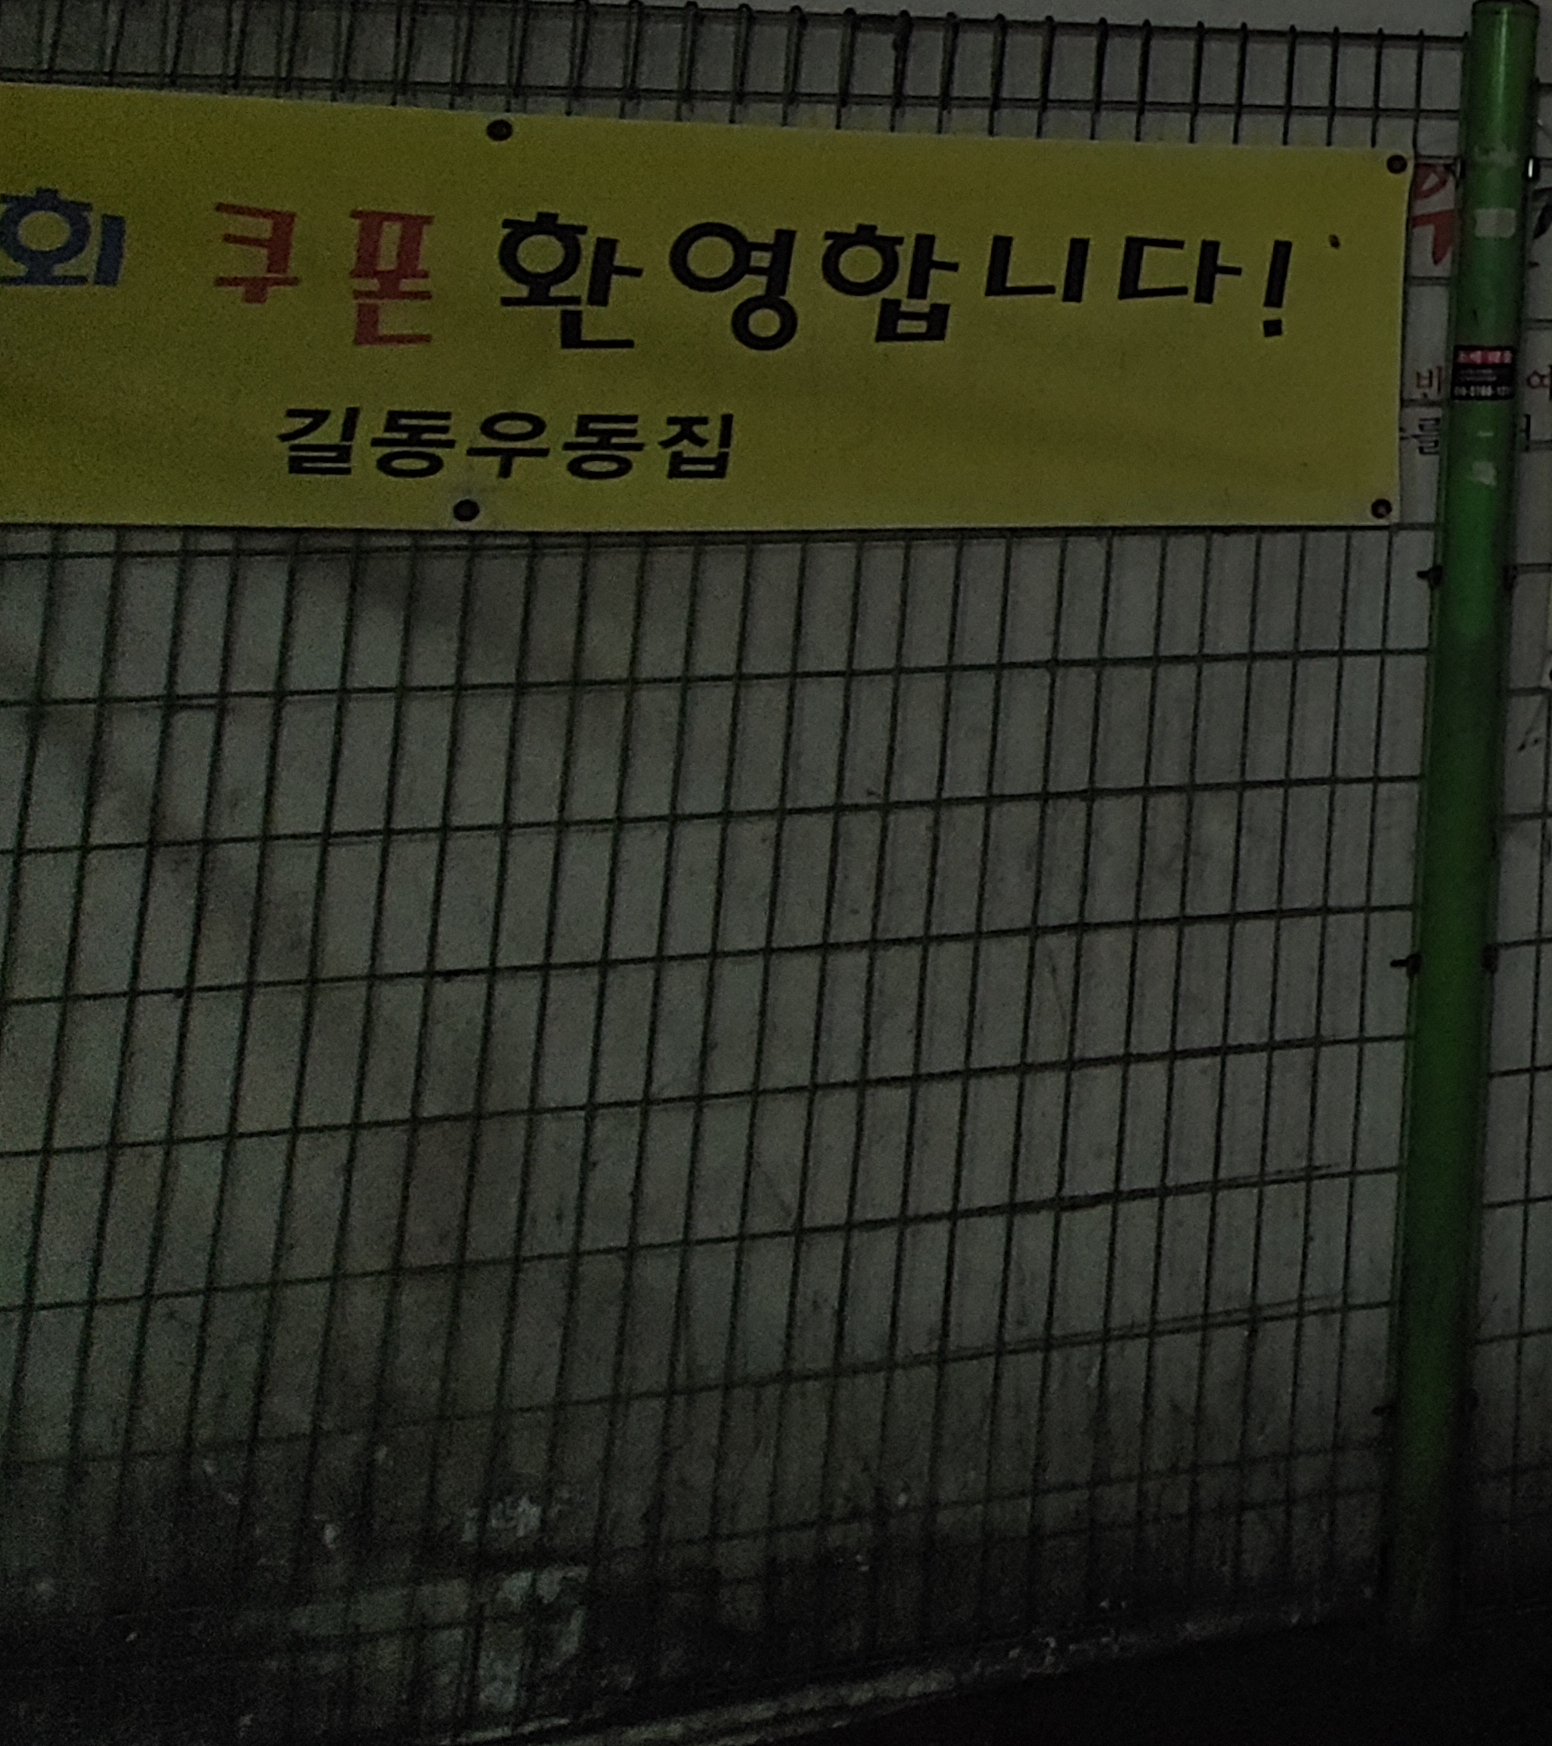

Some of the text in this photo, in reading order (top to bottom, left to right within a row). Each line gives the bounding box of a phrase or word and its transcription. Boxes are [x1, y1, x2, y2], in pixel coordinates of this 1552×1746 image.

[213, 202, 435, 347] 쿠폰
[498, 211, 1293, 350] 환영합니다!
[277, 406, 735, 480] 길동우동집
